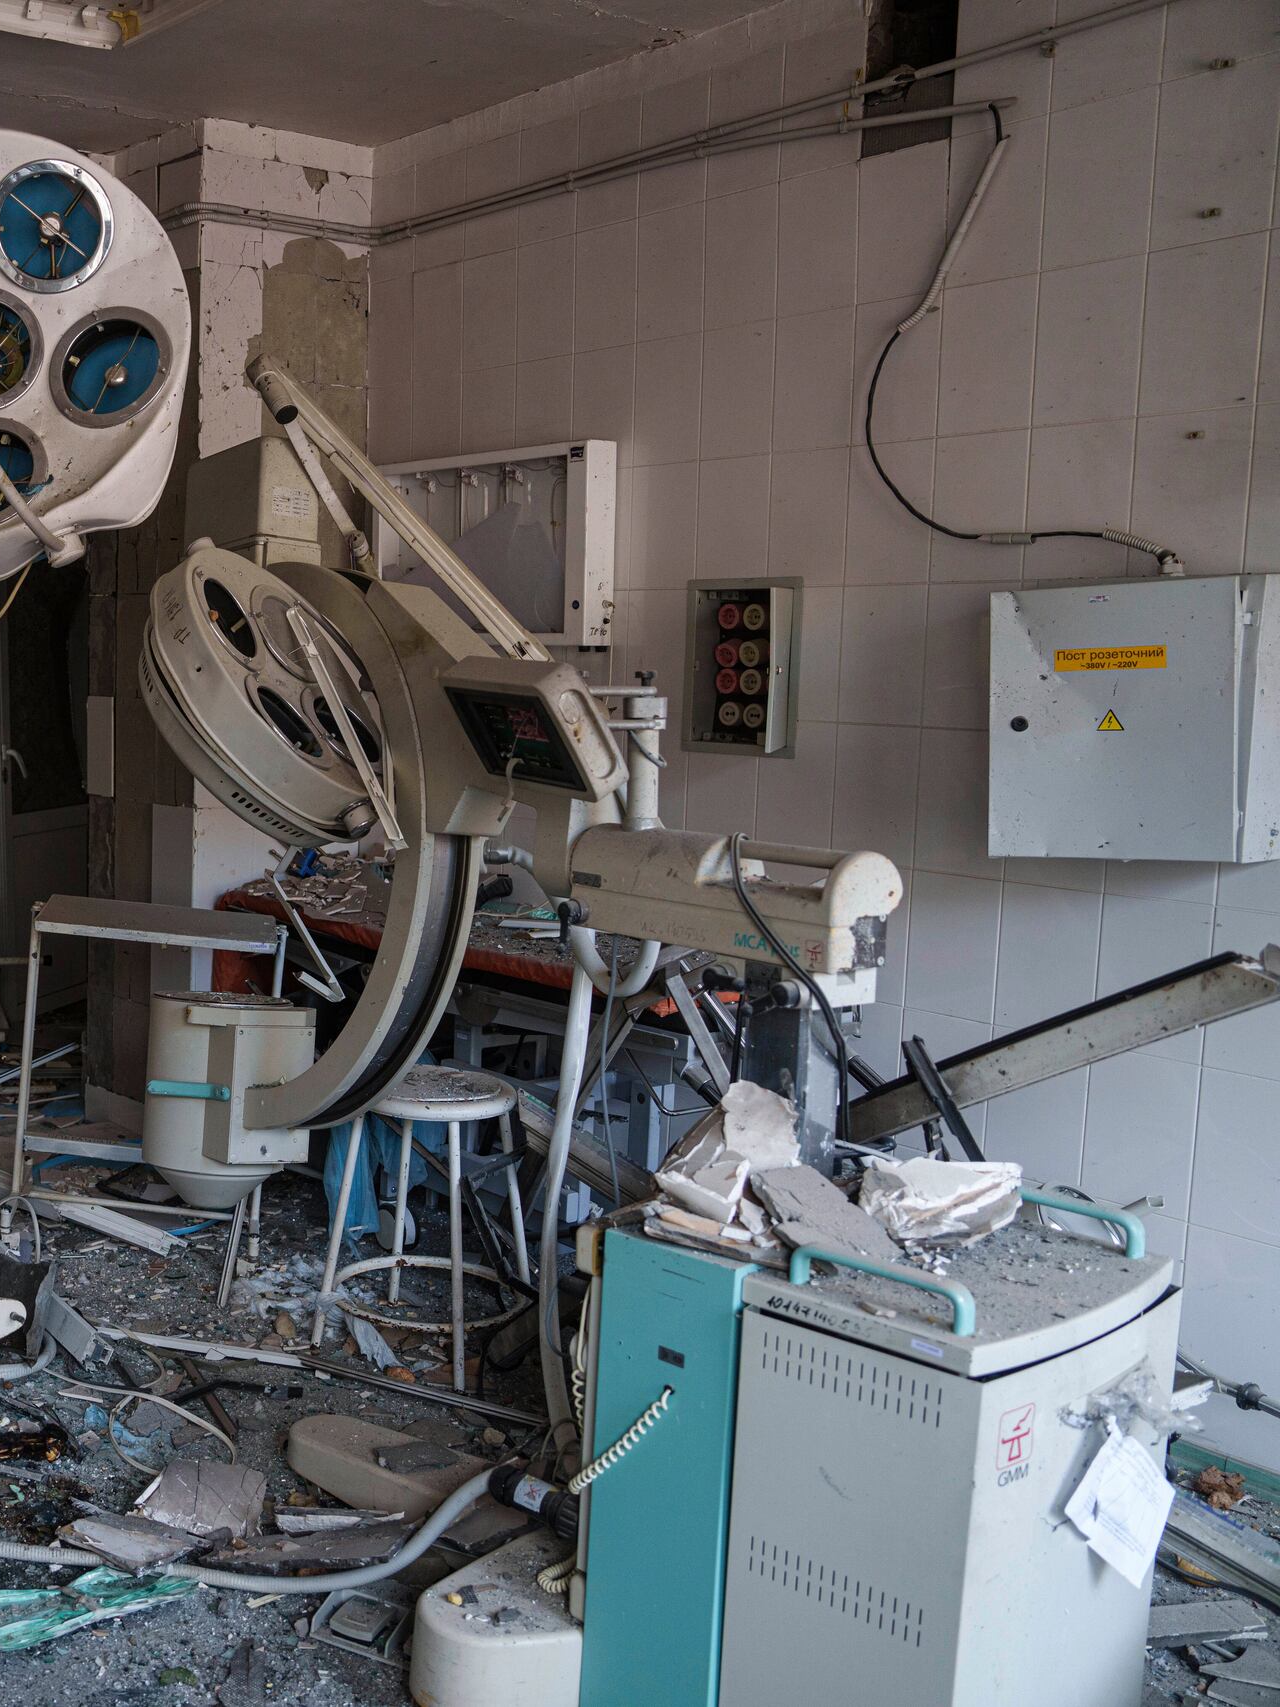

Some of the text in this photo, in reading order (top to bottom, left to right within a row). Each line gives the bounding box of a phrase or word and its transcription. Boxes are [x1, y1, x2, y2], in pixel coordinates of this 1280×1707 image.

[1056, 647, 1164, 661] Пост розеточний
[734, 933, 768, 951] MCA
[997, 1463, 1029, 1487] GMM
